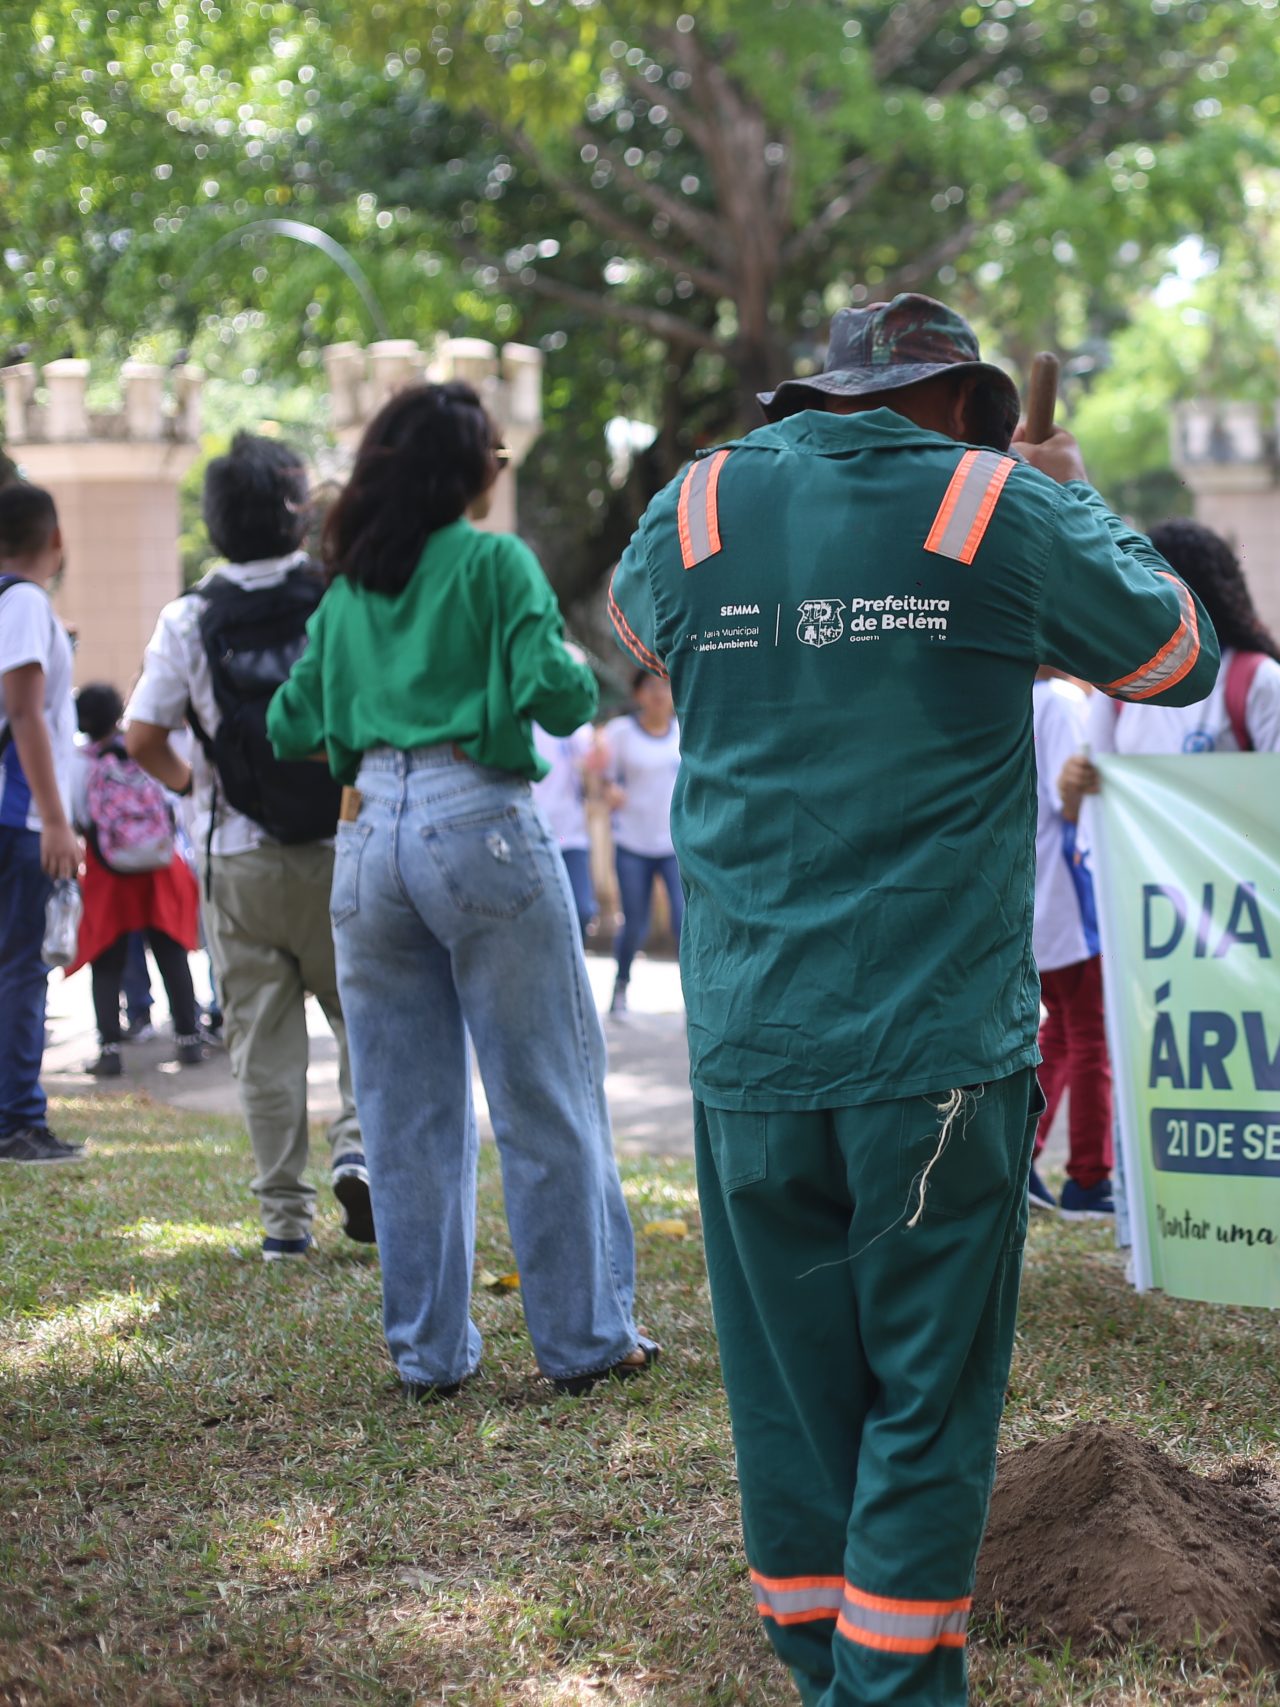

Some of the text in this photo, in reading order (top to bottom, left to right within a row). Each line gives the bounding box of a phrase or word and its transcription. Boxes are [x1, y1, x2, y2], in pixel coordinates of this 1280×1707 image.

[720, 604, 760, 617] SEMMA
[851, 595, 950, 613] Prefeitura
[850, 612, 947, 631] de Belém
[718, 639, 759, 650] Ambiente
[1142, 882, 1271, 960] DIA
[1166, 1119, 1189, 1157] 21
[1195, 1122, 1235, 1159] DE
[1217, 1224, 1278, 1246] uma
